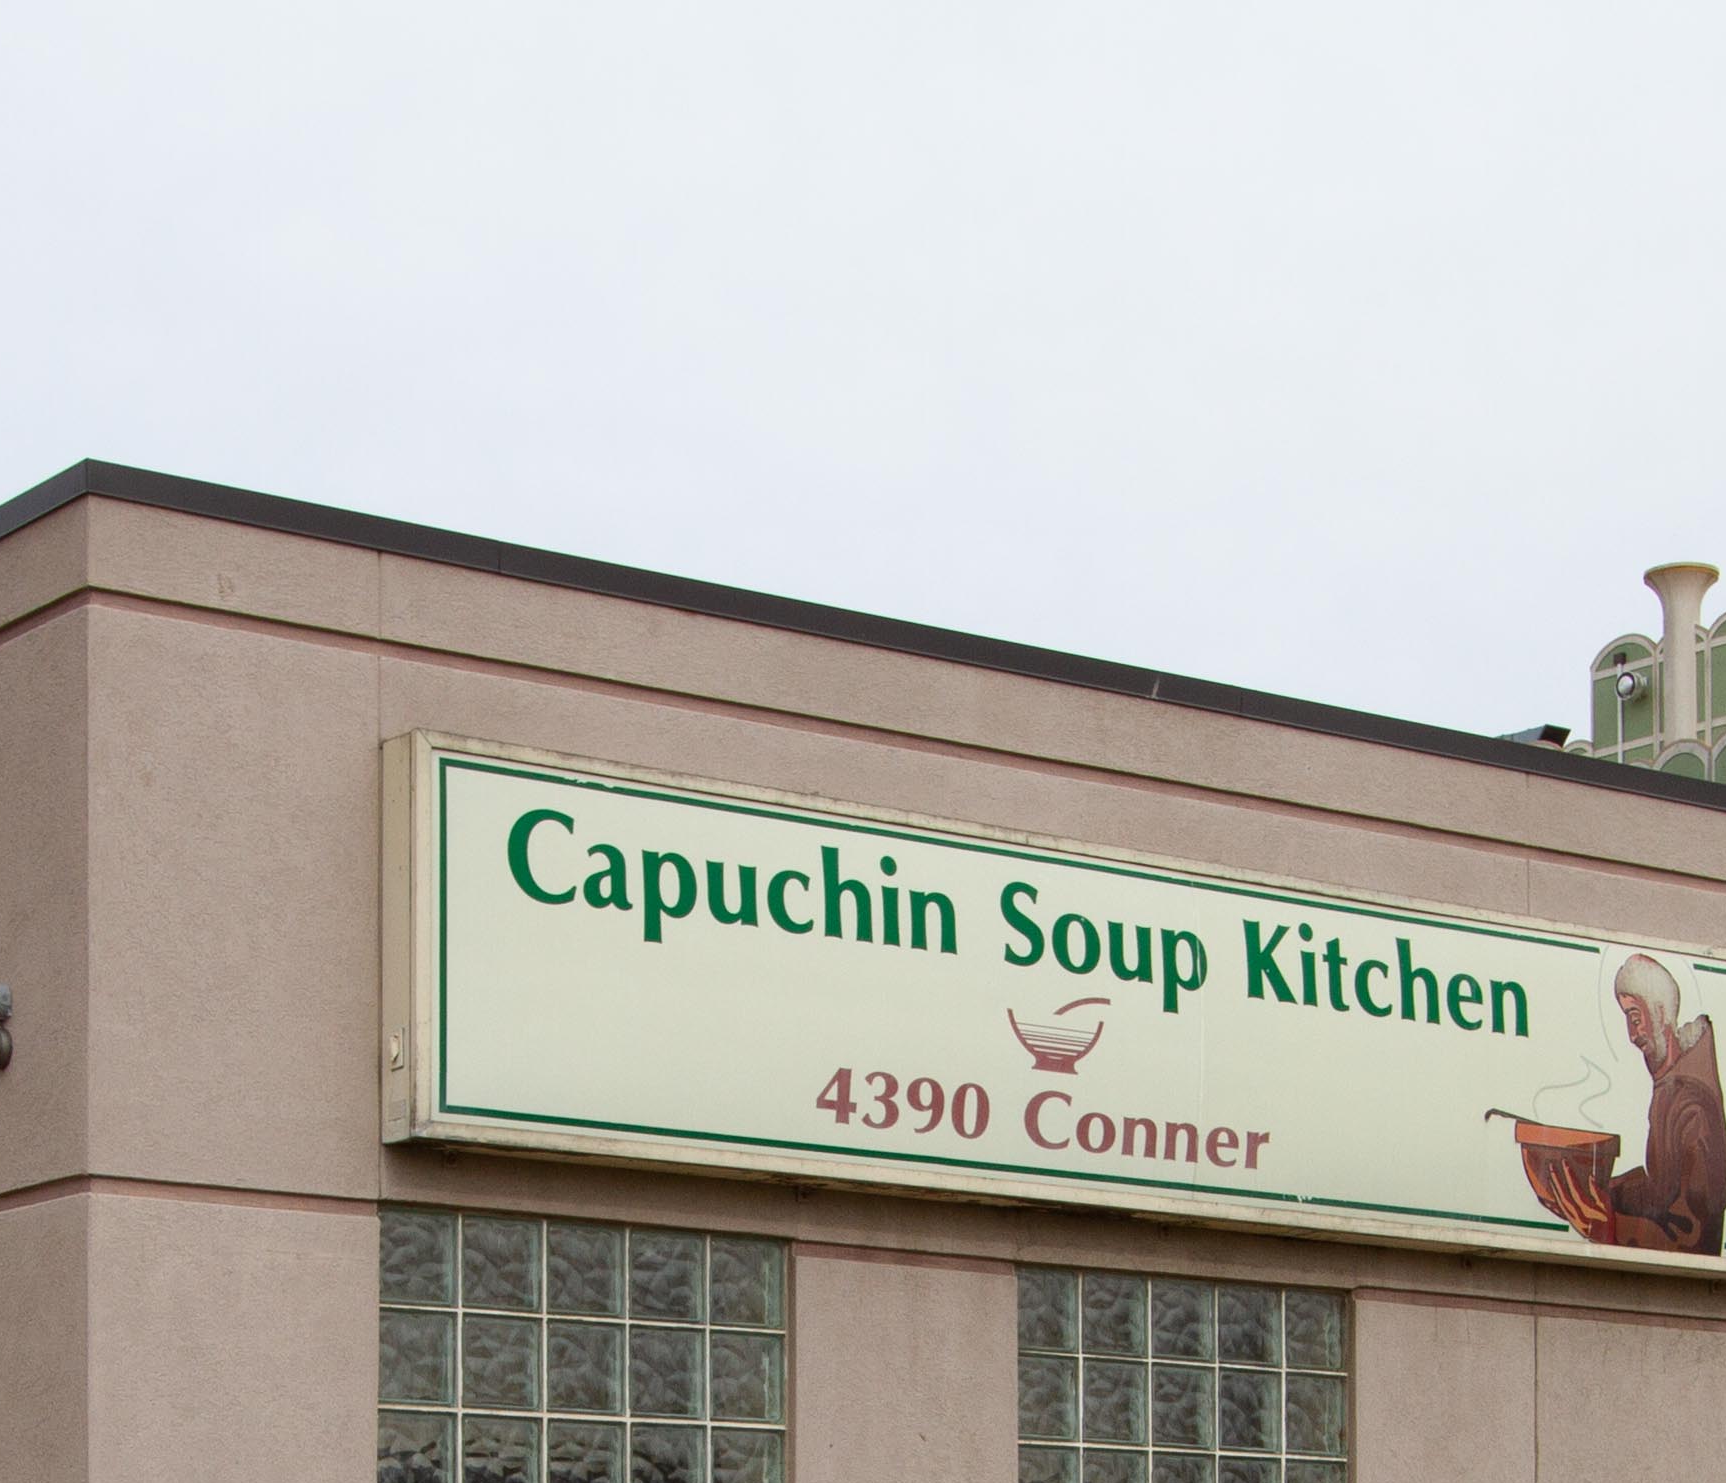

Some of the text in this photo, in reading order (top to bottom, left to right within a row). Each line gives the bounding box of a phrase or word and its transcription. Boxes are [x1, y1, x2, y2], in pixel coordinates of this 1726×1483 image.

[507, 808, 1529, 1036] Capuchin Soup Kitchen
[816, 1069, 1270, 1170] 4390 Conner
